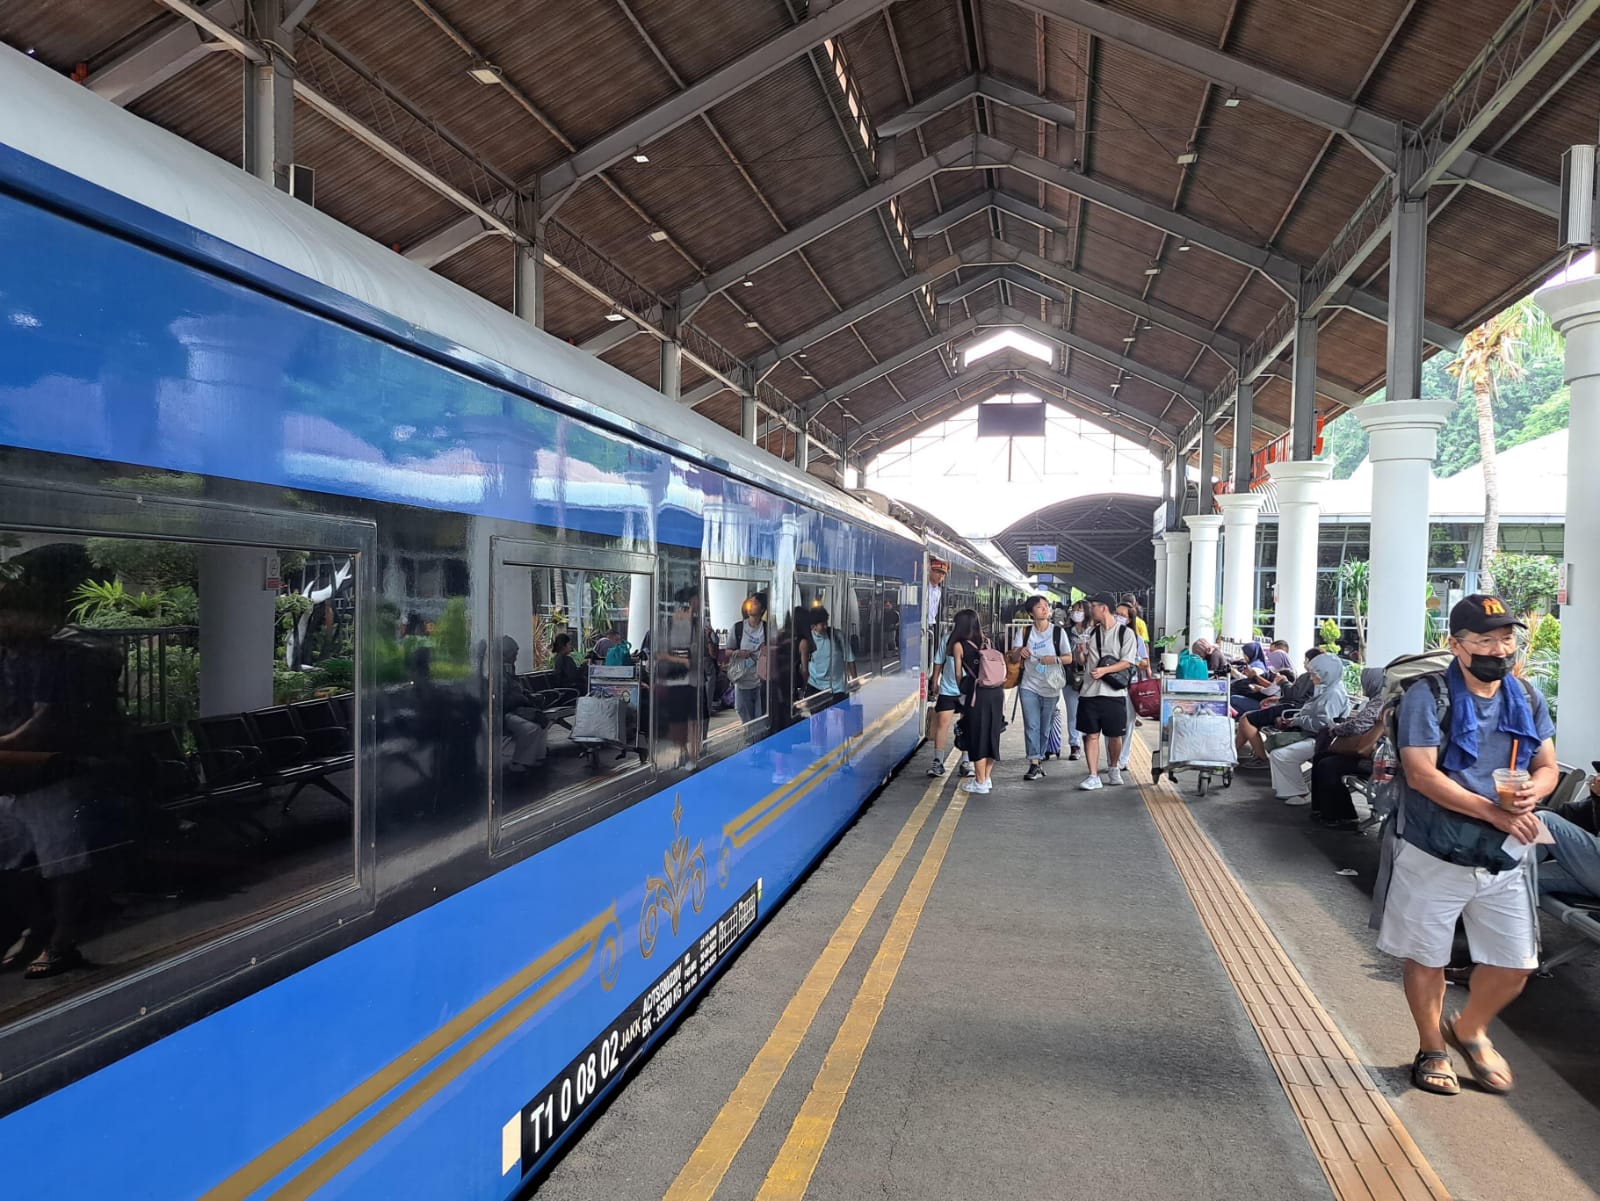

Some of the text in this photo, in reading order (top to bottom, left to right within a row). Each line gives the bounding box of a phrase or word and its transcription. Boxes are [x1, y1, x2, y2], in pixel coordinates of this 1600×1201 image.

[620, 1015, 641, 1052] JAKK
[530, 1030, 619, 1153] T1 0 08 02
